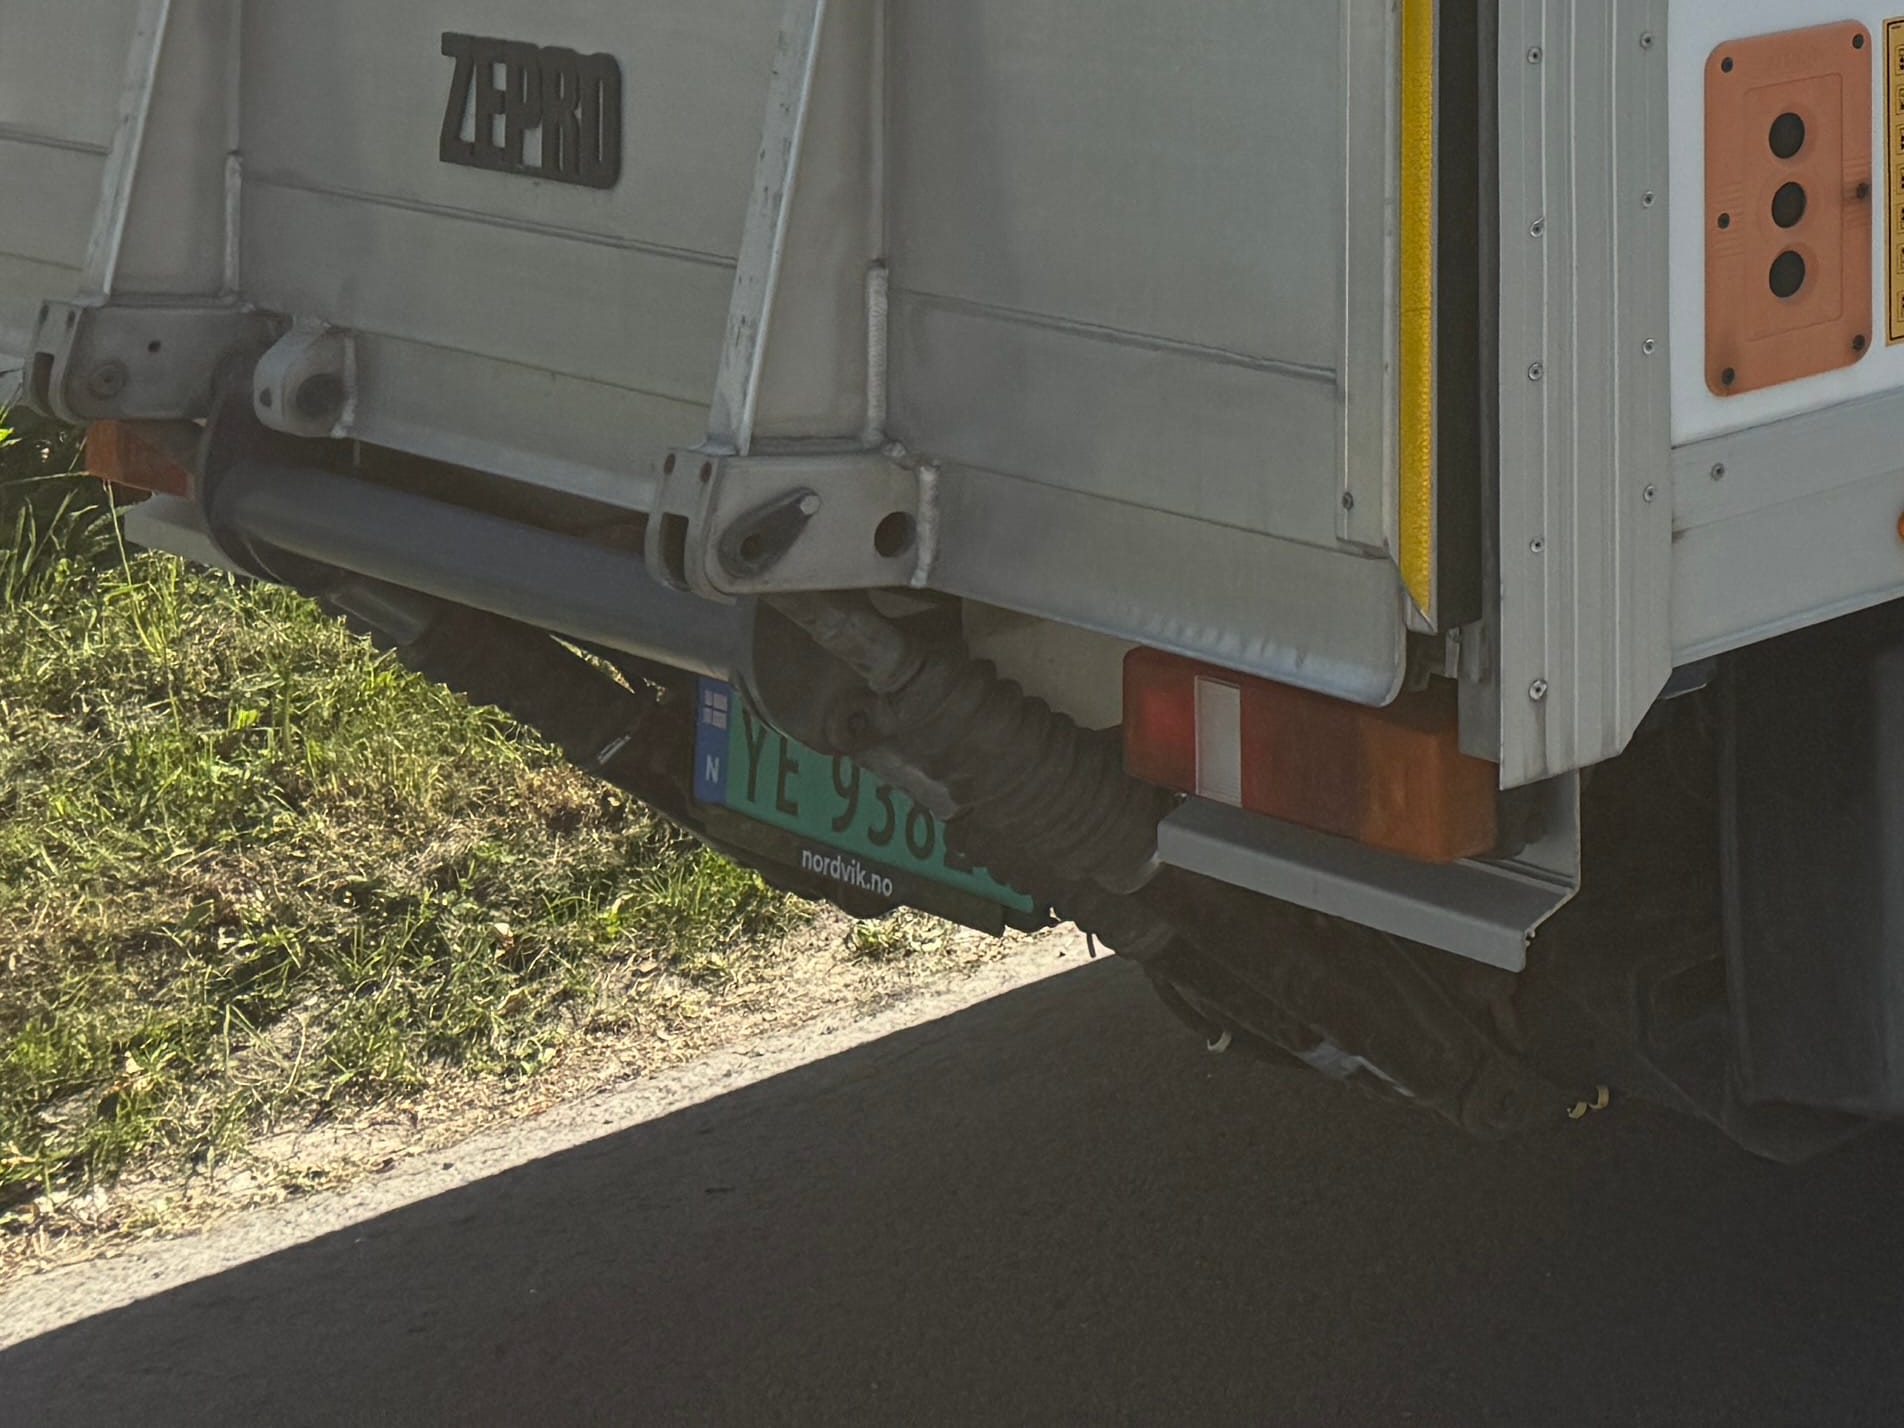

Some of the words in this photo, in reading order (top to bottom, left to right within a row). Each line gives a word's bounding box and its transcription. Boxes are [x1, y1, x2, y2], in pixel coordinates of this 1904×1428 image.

[439, 31, 622, 190] ZEPRO
[705, 755, 721, 785] N
[740, 706, 800, 818] YE
[801, 848, 894, 898] nordvik.no
